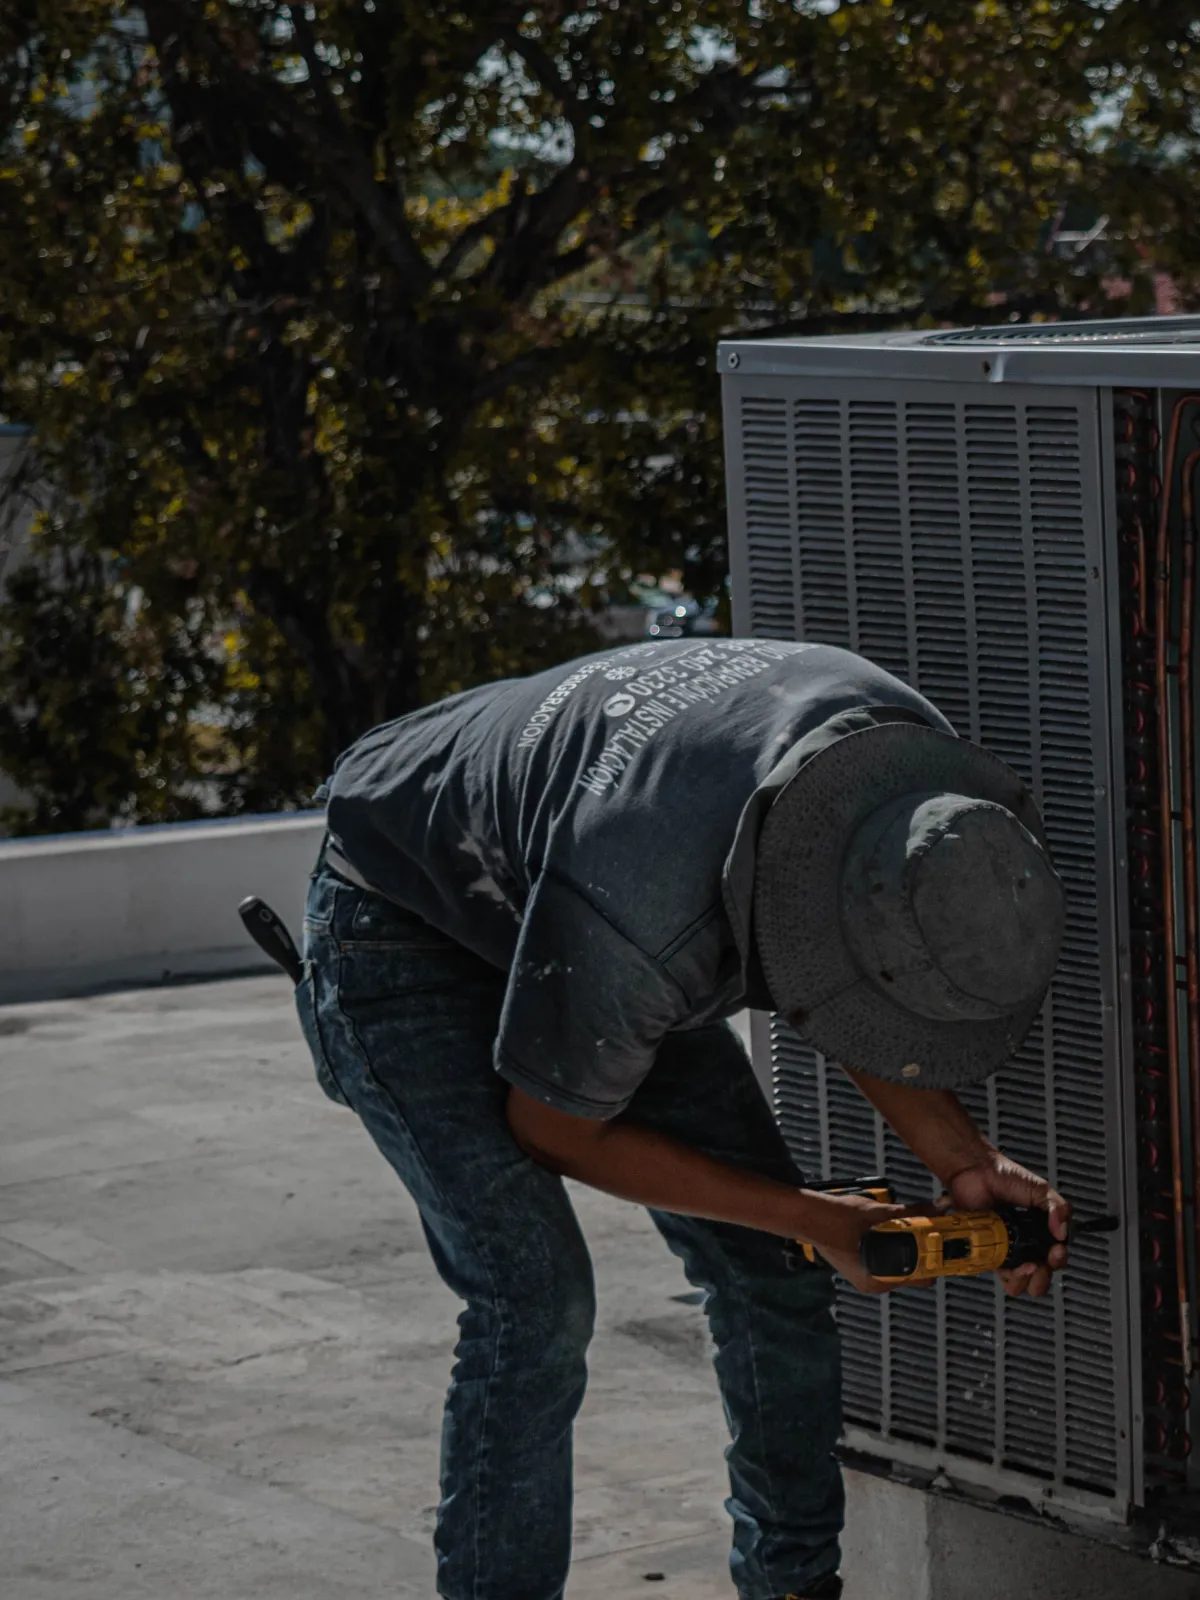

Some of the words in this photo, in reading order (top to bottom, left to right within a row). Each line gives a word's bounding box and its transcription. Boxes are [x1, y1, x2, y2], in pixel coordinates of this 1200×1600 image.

[677, 649, 728, 671] 240
[624, 666, 689, 696] 3230
[578, 698, 678, 797] INSTALACIÓN
